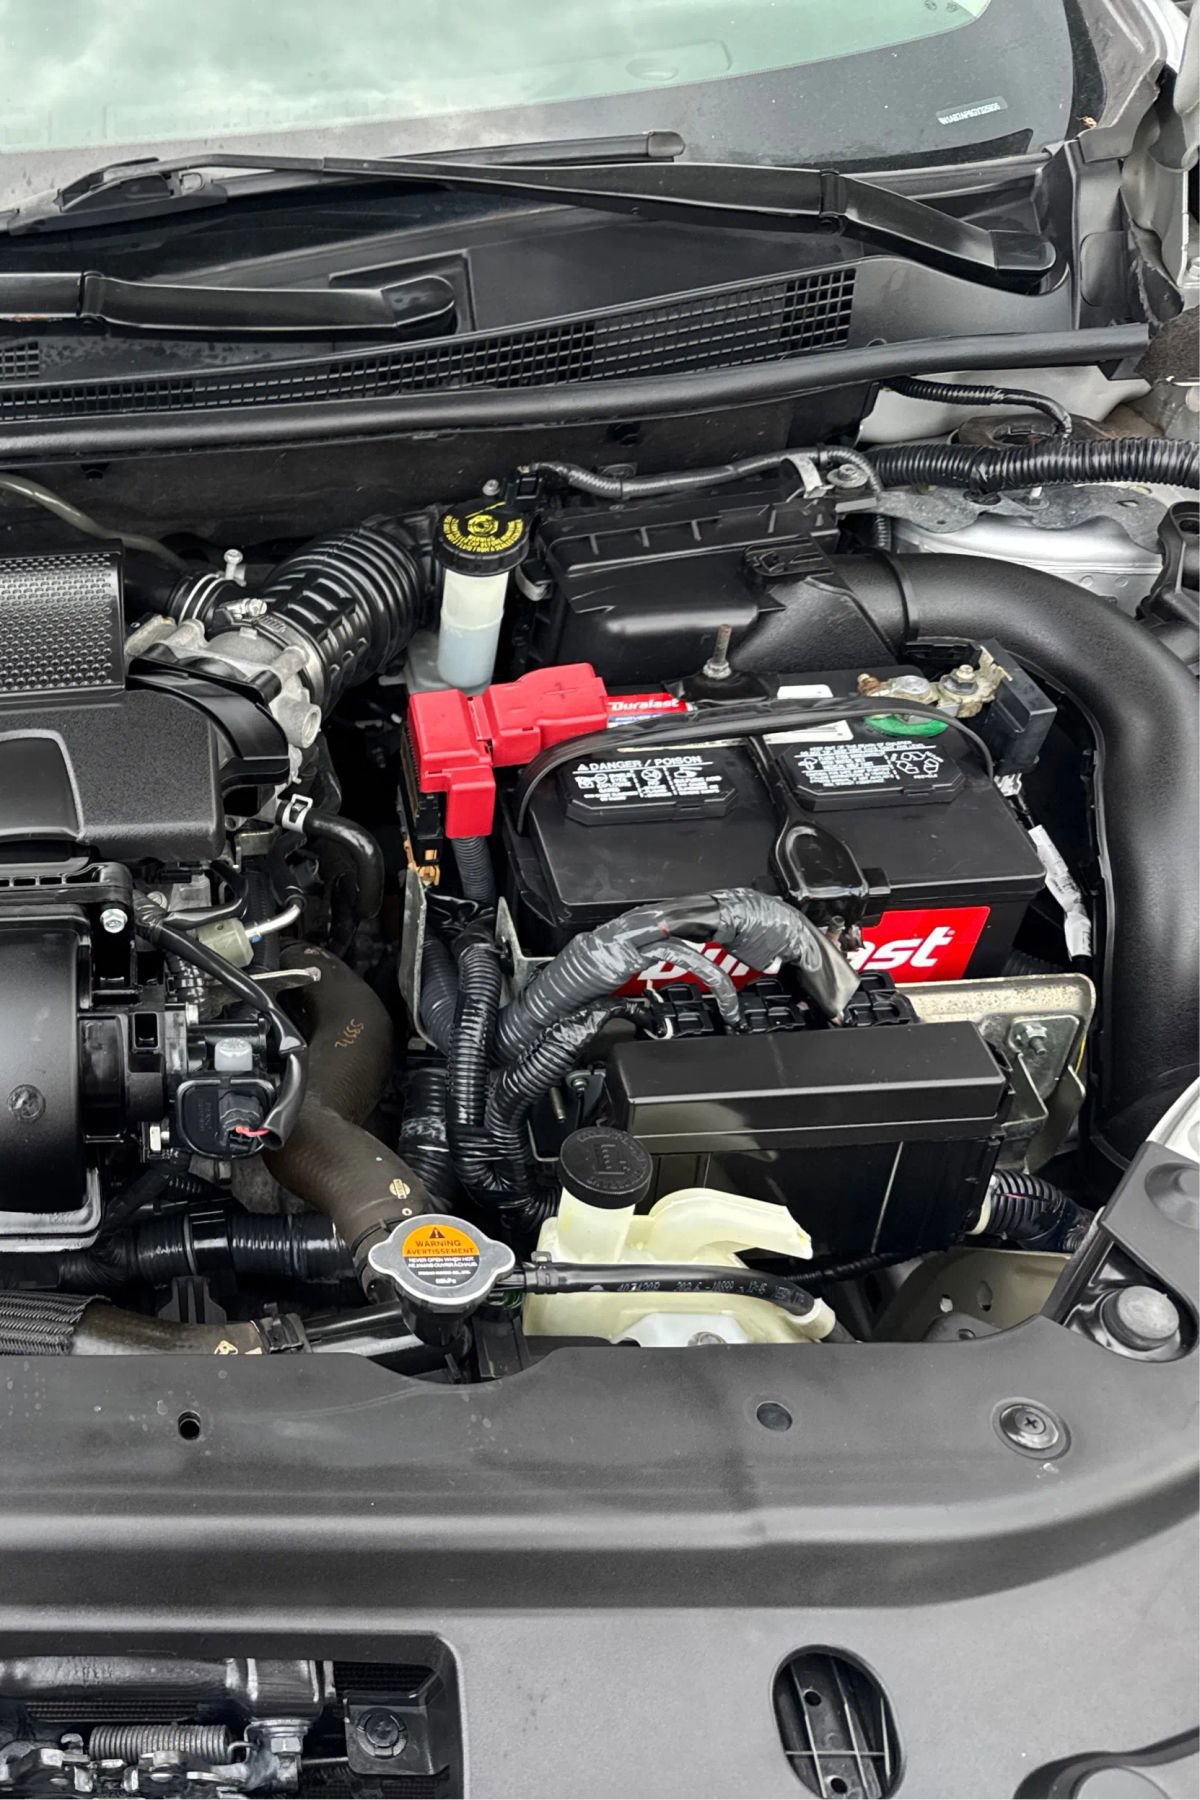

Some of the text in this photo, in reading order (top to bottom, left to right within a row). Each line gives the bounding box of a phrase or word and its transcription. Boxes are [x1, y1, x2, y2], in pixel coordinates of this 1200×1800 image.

[608, 698, 679, 711] Duralast
[589, 760, 642, 771] DANGER
[654, 755, 702, 766] POISON
[415, 1239, 461, 1248] WARNING
[406, 1247, 474, 1255] AVERTISSEMENT
